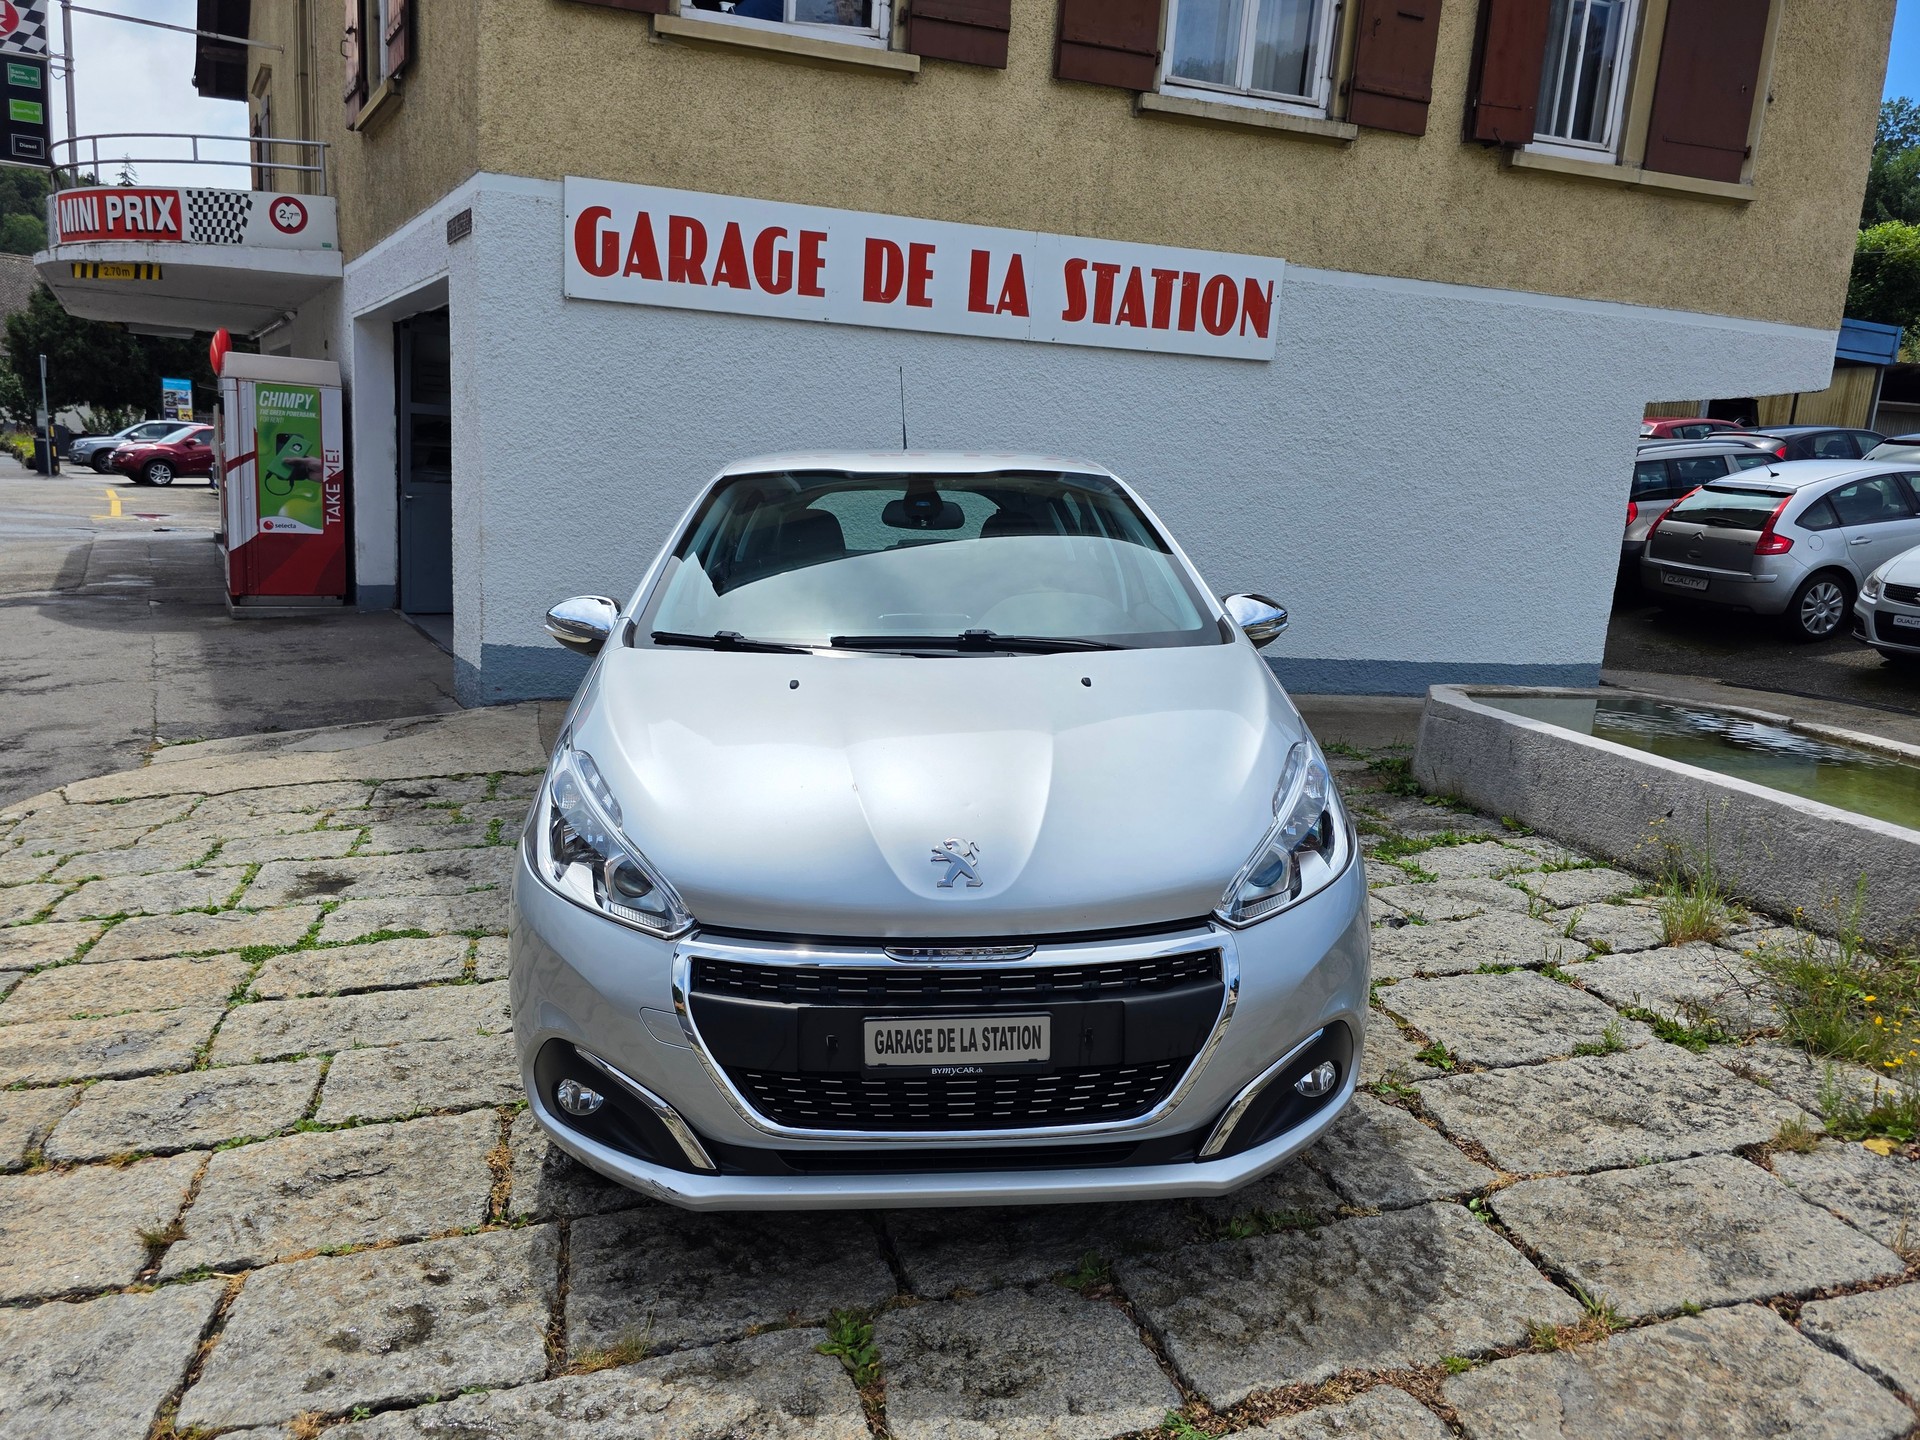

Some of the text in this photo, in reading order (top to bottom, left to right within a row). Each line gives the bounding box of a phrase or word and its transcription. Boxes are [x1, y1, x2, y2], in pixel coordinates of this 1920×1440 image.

[61, 195, 178, 233] MINI PRIX
[574, 206, 1273, 338] GARAGE DE LA STATION
[259, 391, 314, 409] CHIMPY
[325, 449, 341, 525] TAKE ME!
[275, 521, 296, 529] selecta
[1667, 575, 1701, 588] QUALITY
[875, 1025, 1041, 1054] GARAGE DE LA STATION
